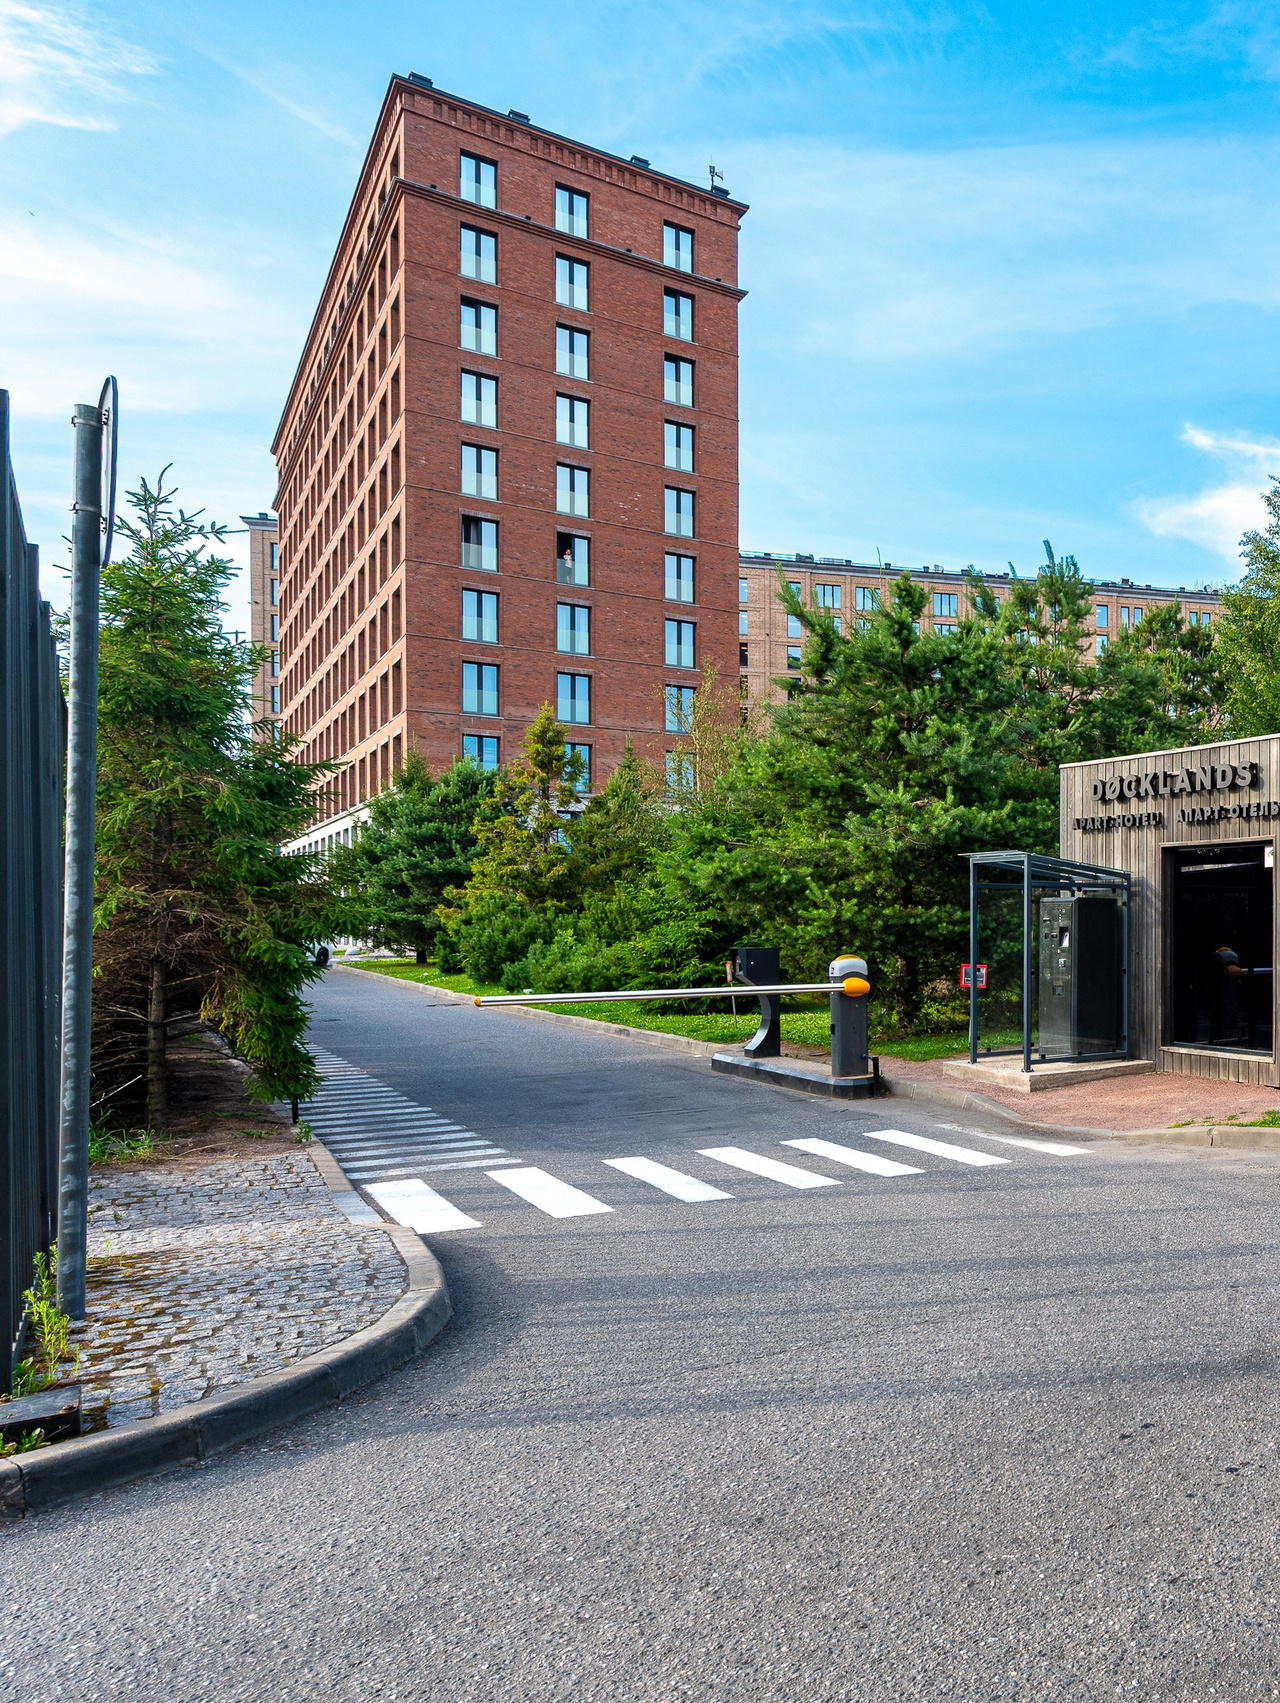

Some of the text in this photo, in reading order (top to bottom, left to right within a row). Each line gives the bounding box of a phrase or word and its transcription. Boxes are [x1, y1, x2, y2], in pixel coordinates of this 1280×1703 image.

[1091, 760, 1253, 801] DØCKLANDS
[1072, 812, 1156, 830] APART HOTEL
[1176, 801, 1280, 822] АПАРТ ОТЕЛЬ
